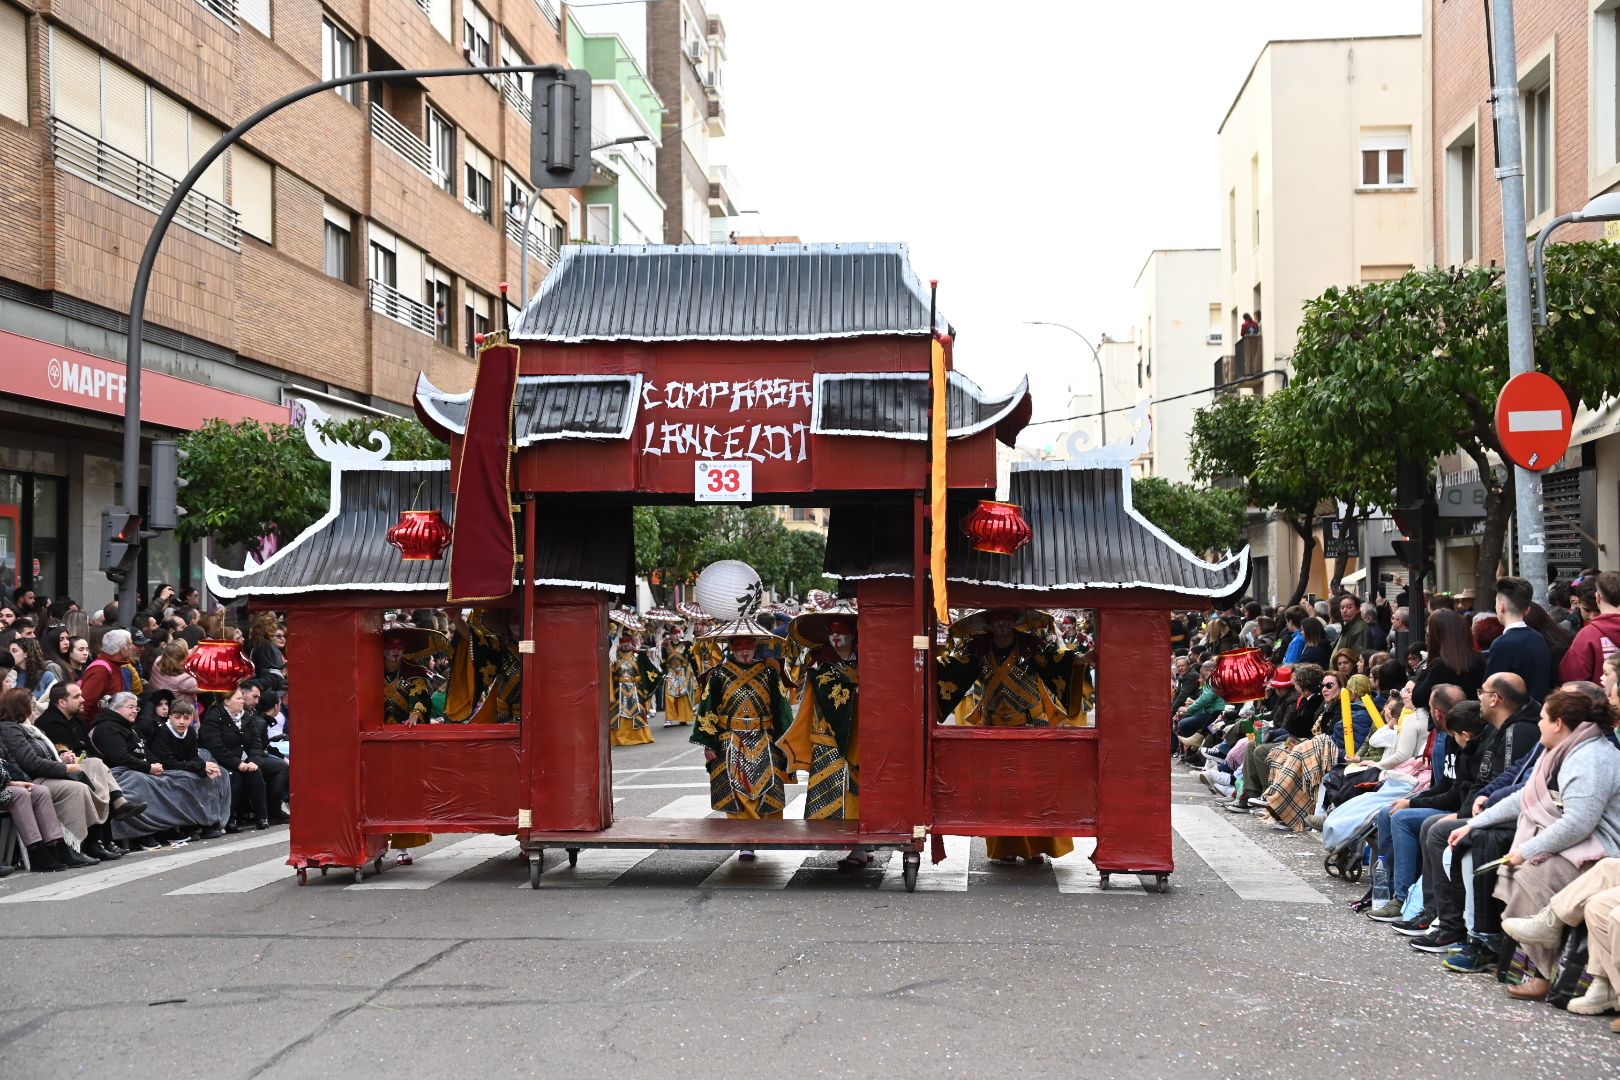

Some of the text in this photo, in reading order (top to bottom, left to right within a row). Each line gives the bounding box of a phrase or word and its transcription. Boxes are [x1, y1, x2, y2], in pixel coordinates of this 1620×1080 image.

[642, 377, 812, 412] COMPARSA
[642, 420, 811, 463] LANCELOT
[707, 468, 740, 493] 33
